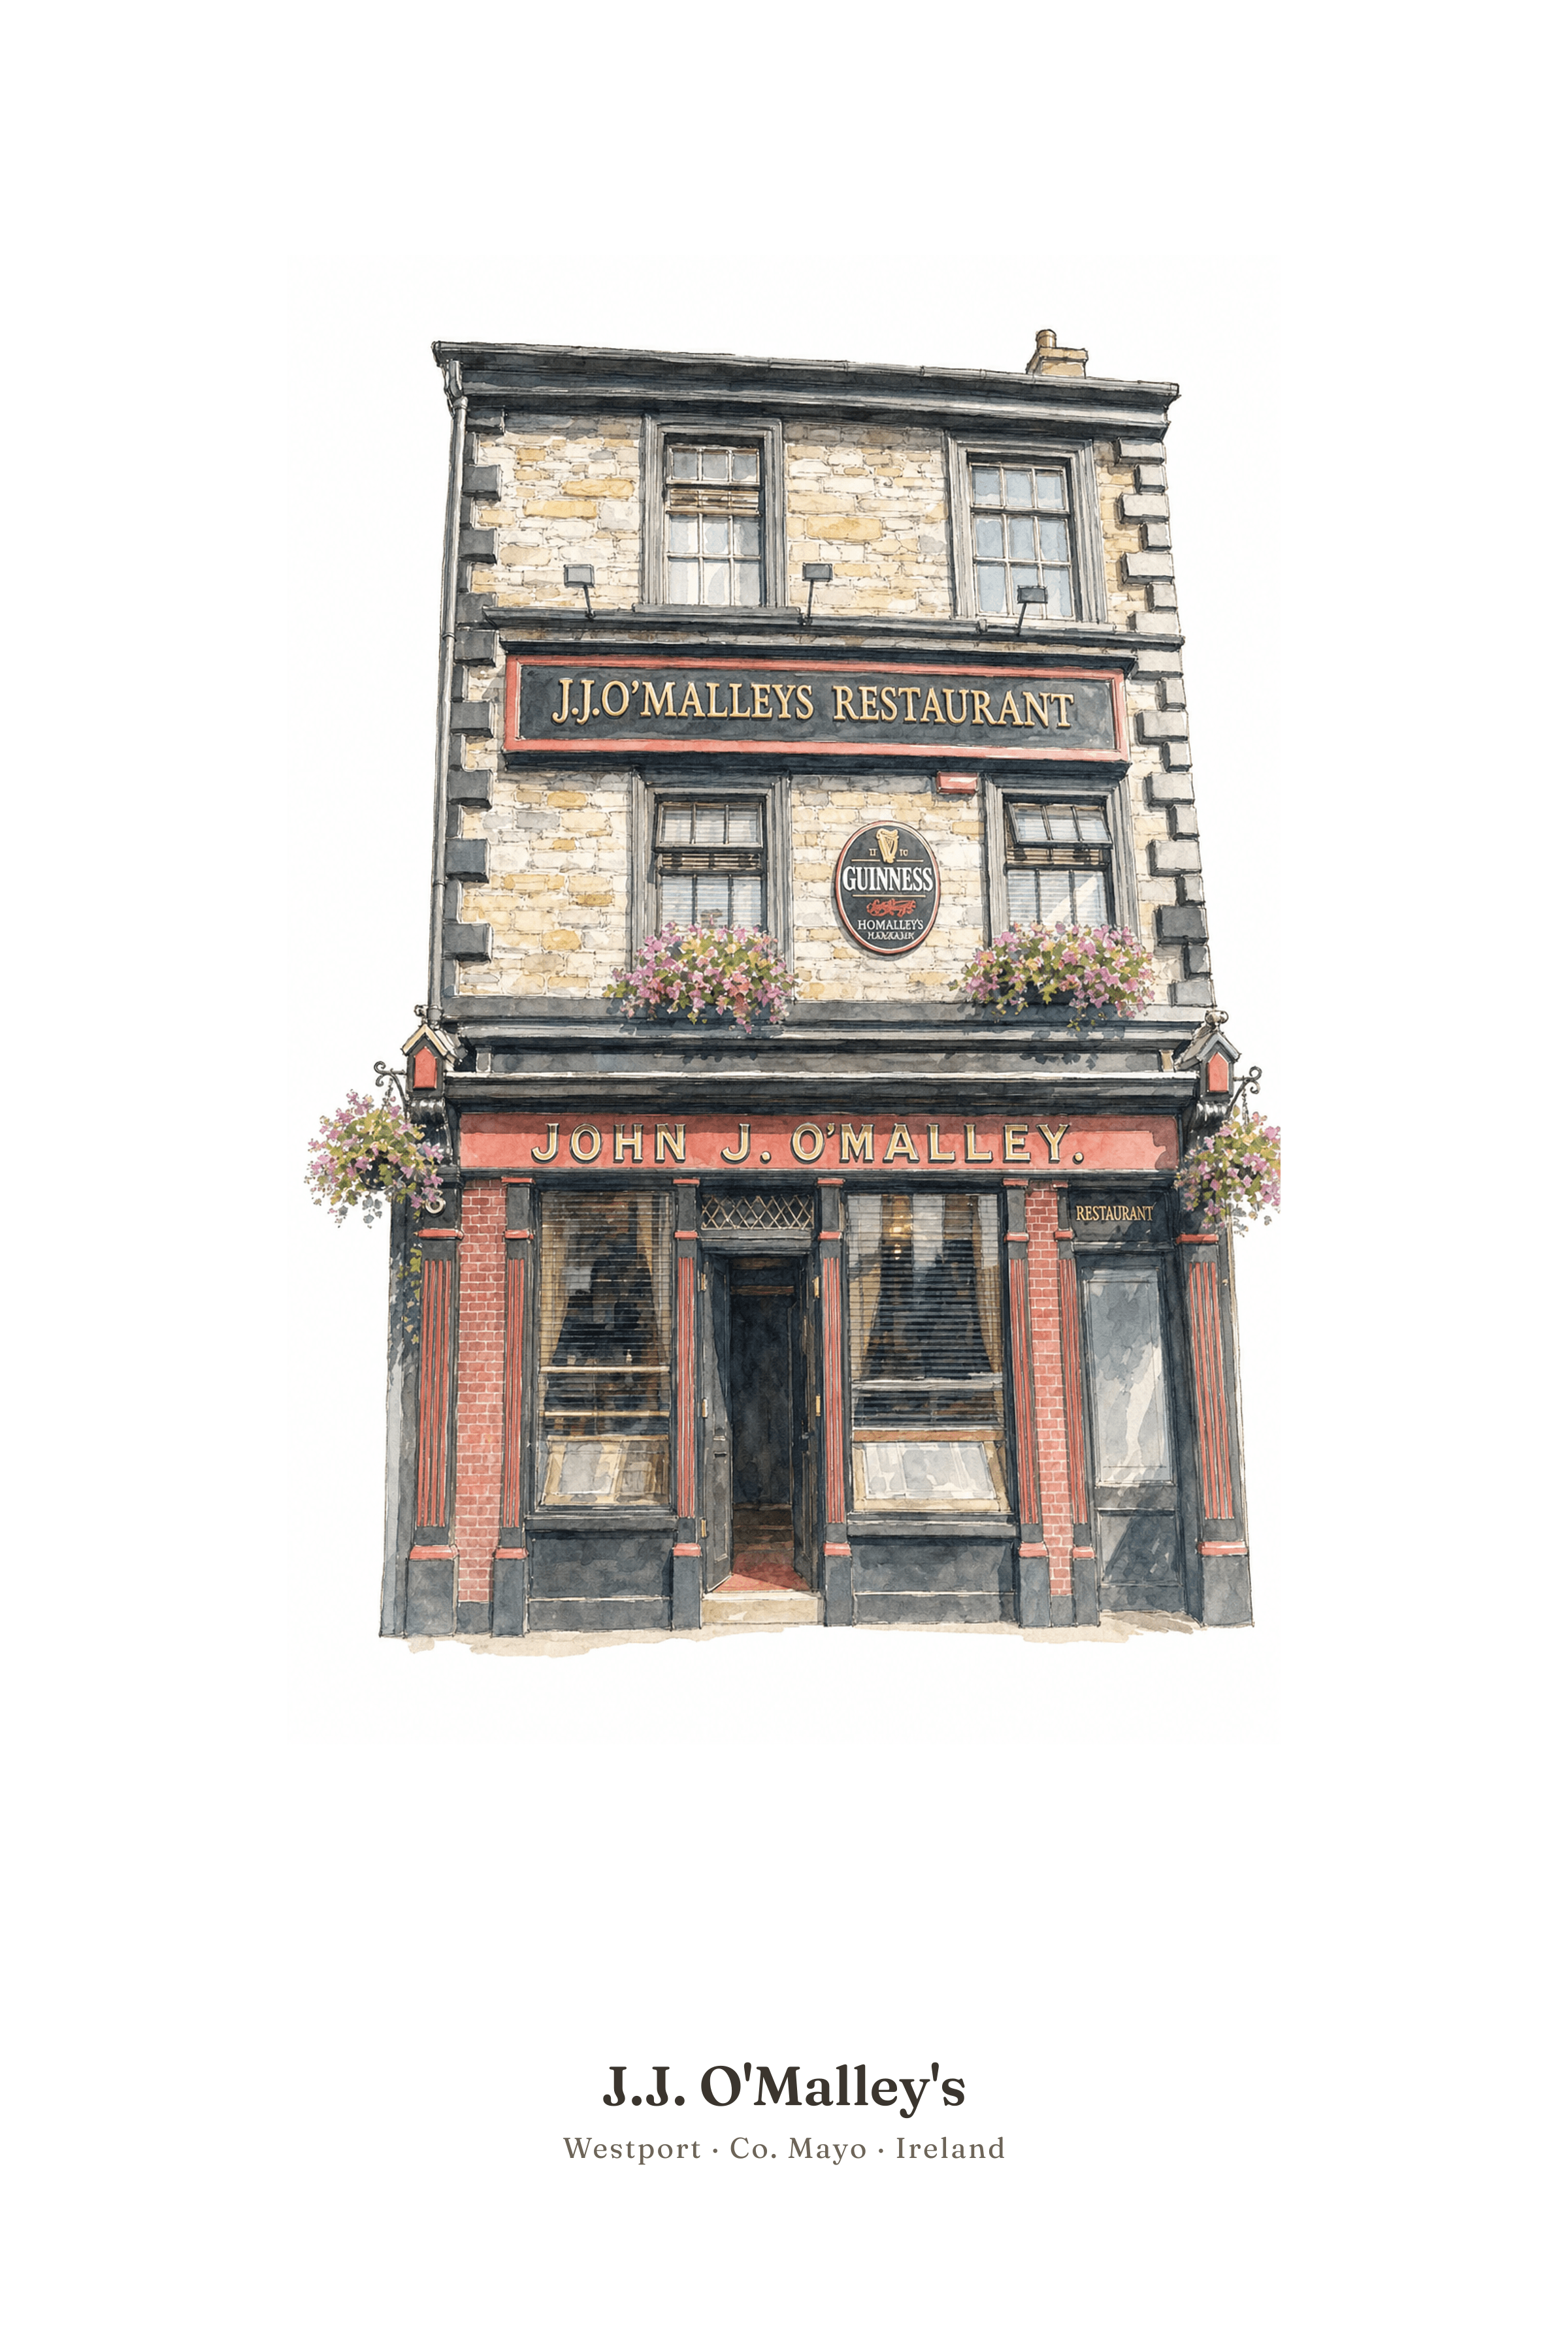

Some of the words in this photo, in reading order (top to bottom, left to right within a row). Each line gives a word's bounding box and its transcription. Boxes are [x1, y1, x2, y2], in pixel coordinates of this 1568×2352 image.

[552, 678, 814, 724] J.J.O'MALLEYS
[832, 685, 1075, 728] RESTAURANT
[842, 866, 934, 891] GUINNESS
[531, 1122, 687, 1164] JOHN
[721, 1122, 772, 1164] J.
[791, 1122, 1085, 1164] O'MALLEY.
[1076, 1205, 1154, 1221] RESTAURANT
